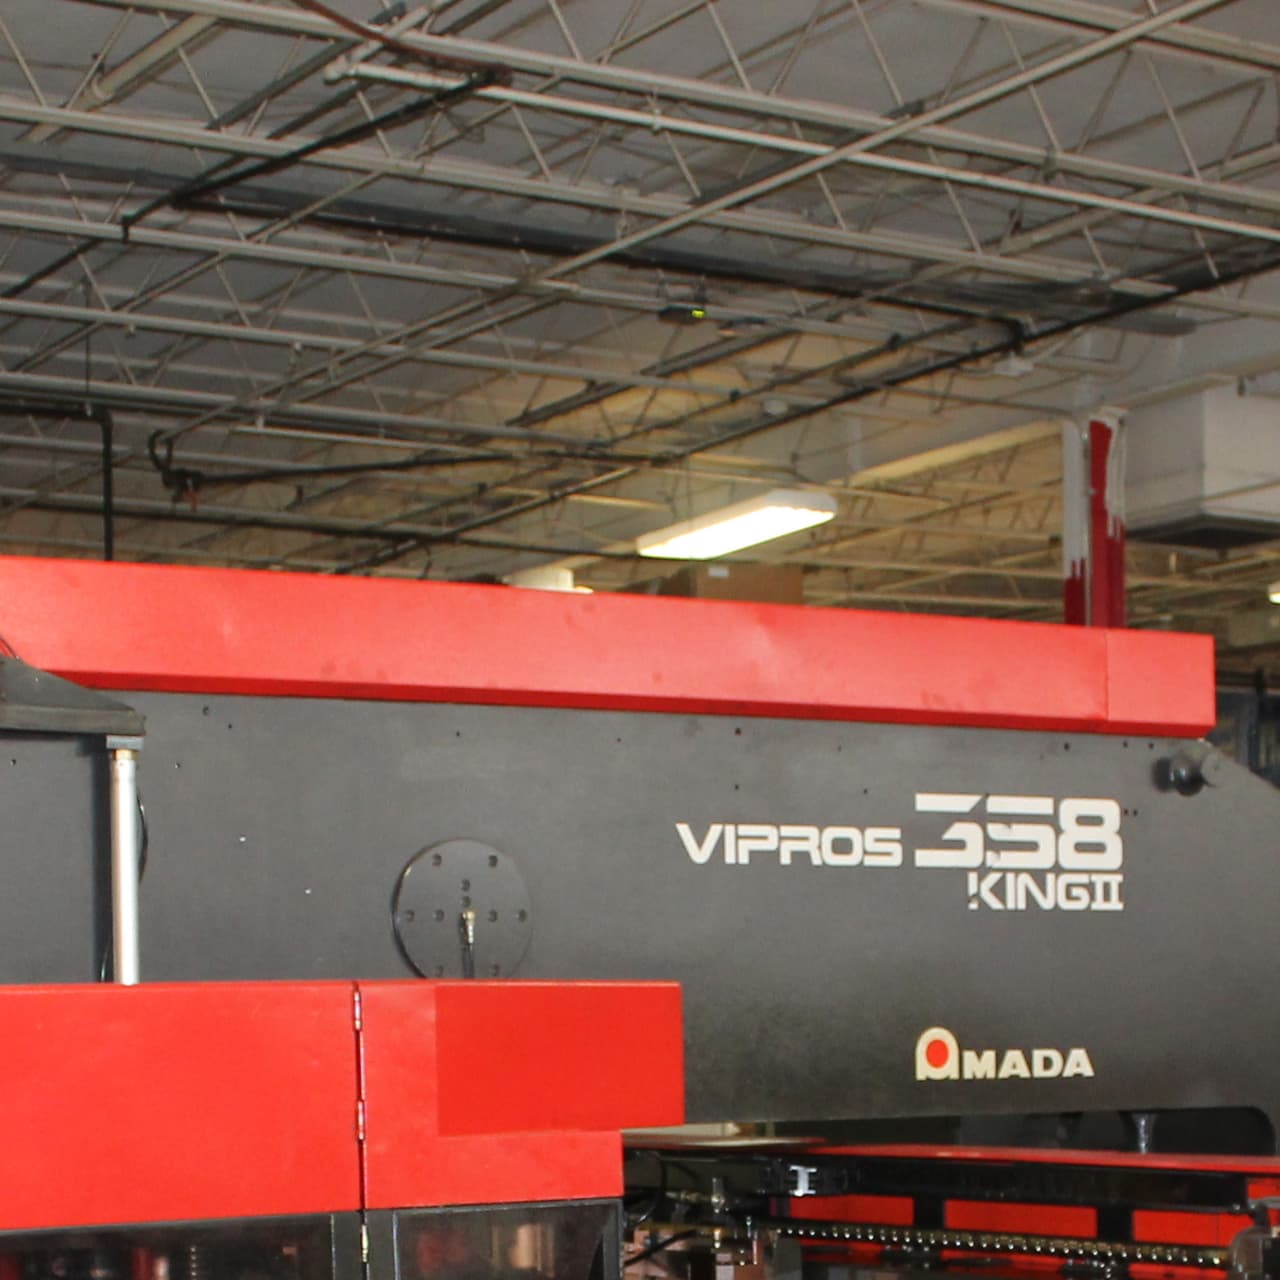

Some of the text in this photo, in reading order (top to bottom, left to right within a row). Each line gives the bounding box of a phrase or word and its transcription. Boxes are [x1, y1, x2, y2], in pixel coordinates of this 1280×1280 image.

[675, 793, 1124, 871] VIPROS 358
[915, 1025, 1096, 1081] AMADA
